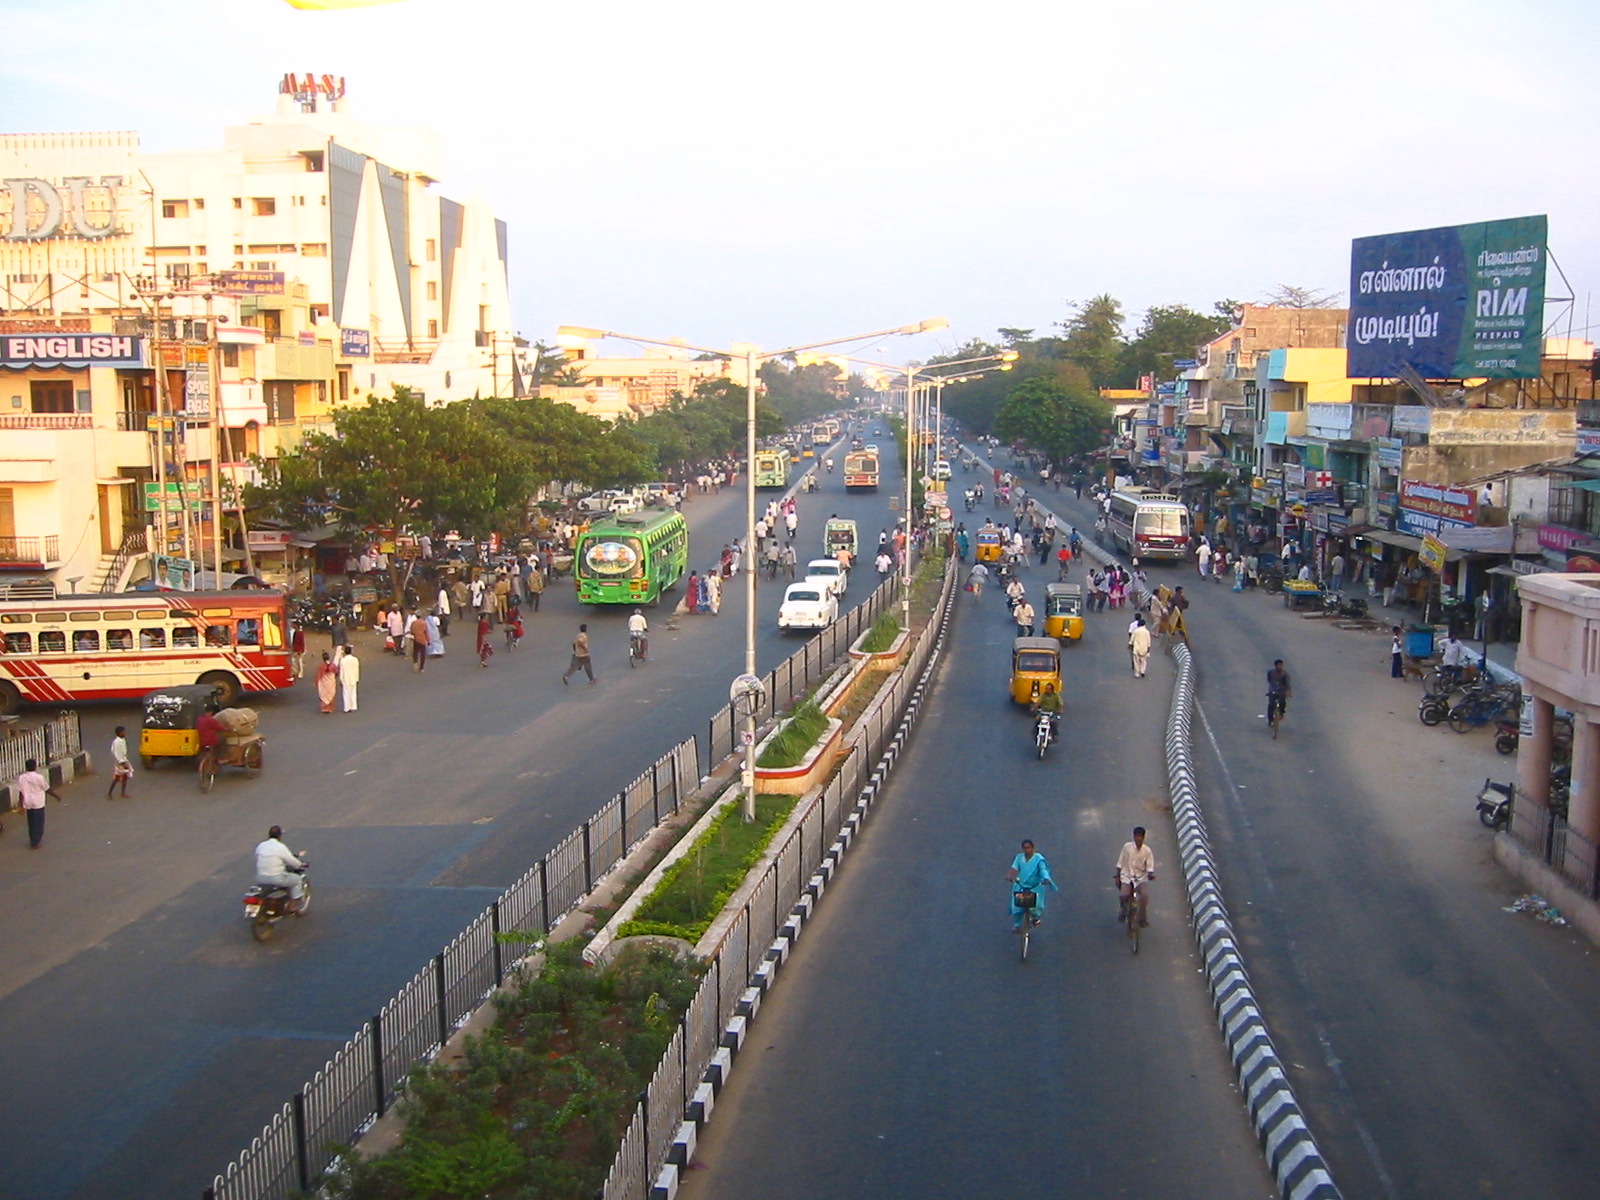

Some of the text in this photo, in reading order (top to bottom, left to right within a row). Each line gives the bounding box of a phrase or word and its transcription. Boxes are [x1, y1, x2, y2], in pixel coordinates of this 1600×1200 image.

[1360, 256, 1445, 294] என்னால்
[1476, 287, 1528, 317] RIM
[1356, 306, 1439, 346] முடியும்!
[1475, 331, 1520, 339] PREPAID
[8, 337, 132, 358] ENGLISH
